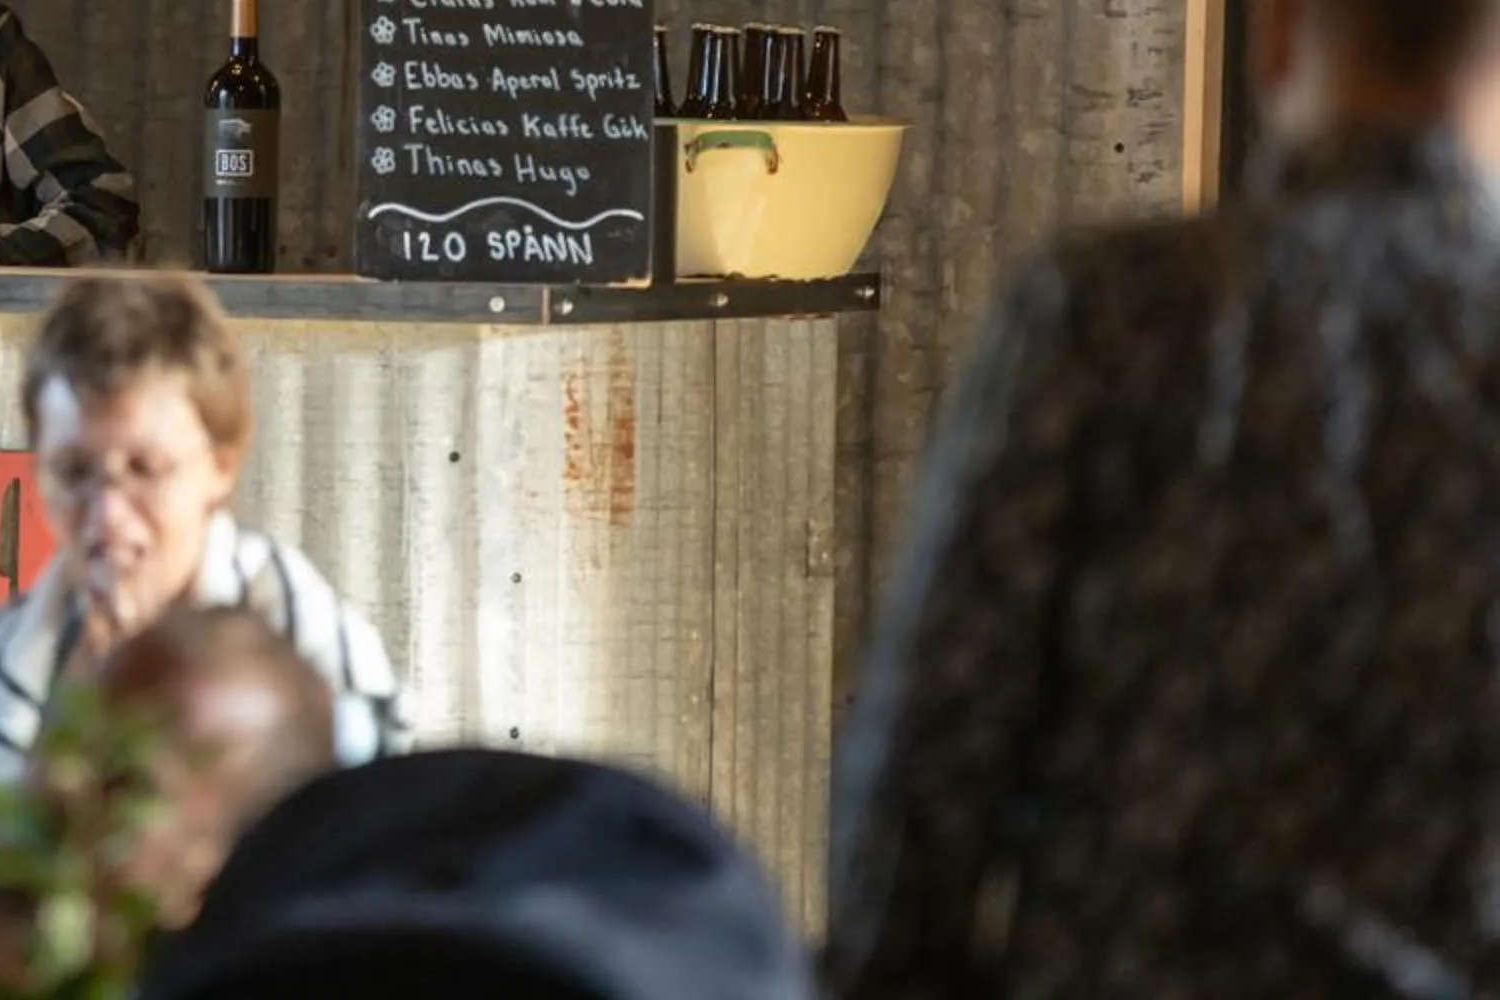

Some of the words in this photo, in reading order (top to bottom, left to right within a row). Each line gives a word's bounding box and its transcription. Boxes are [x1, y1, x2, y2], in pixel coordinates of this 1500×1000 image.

[402, 17, 470, 47] Tinas
[404, 61, 480, 91] Ebbas
[491, 66, 562, 100] Aperol
[569, 66, 642, 101] Spritz
[408, 104, 510, 136] Felicias
[520, 112, 595, 139] Kaffe
[221, 153, 247, 171] BOS
[403, 143, 504, 177] Thinas
[513, 152, 592, 197] Hugo
[402, 231, 467, 263] 120
[487, 225, 595, 265] SPÅNN
